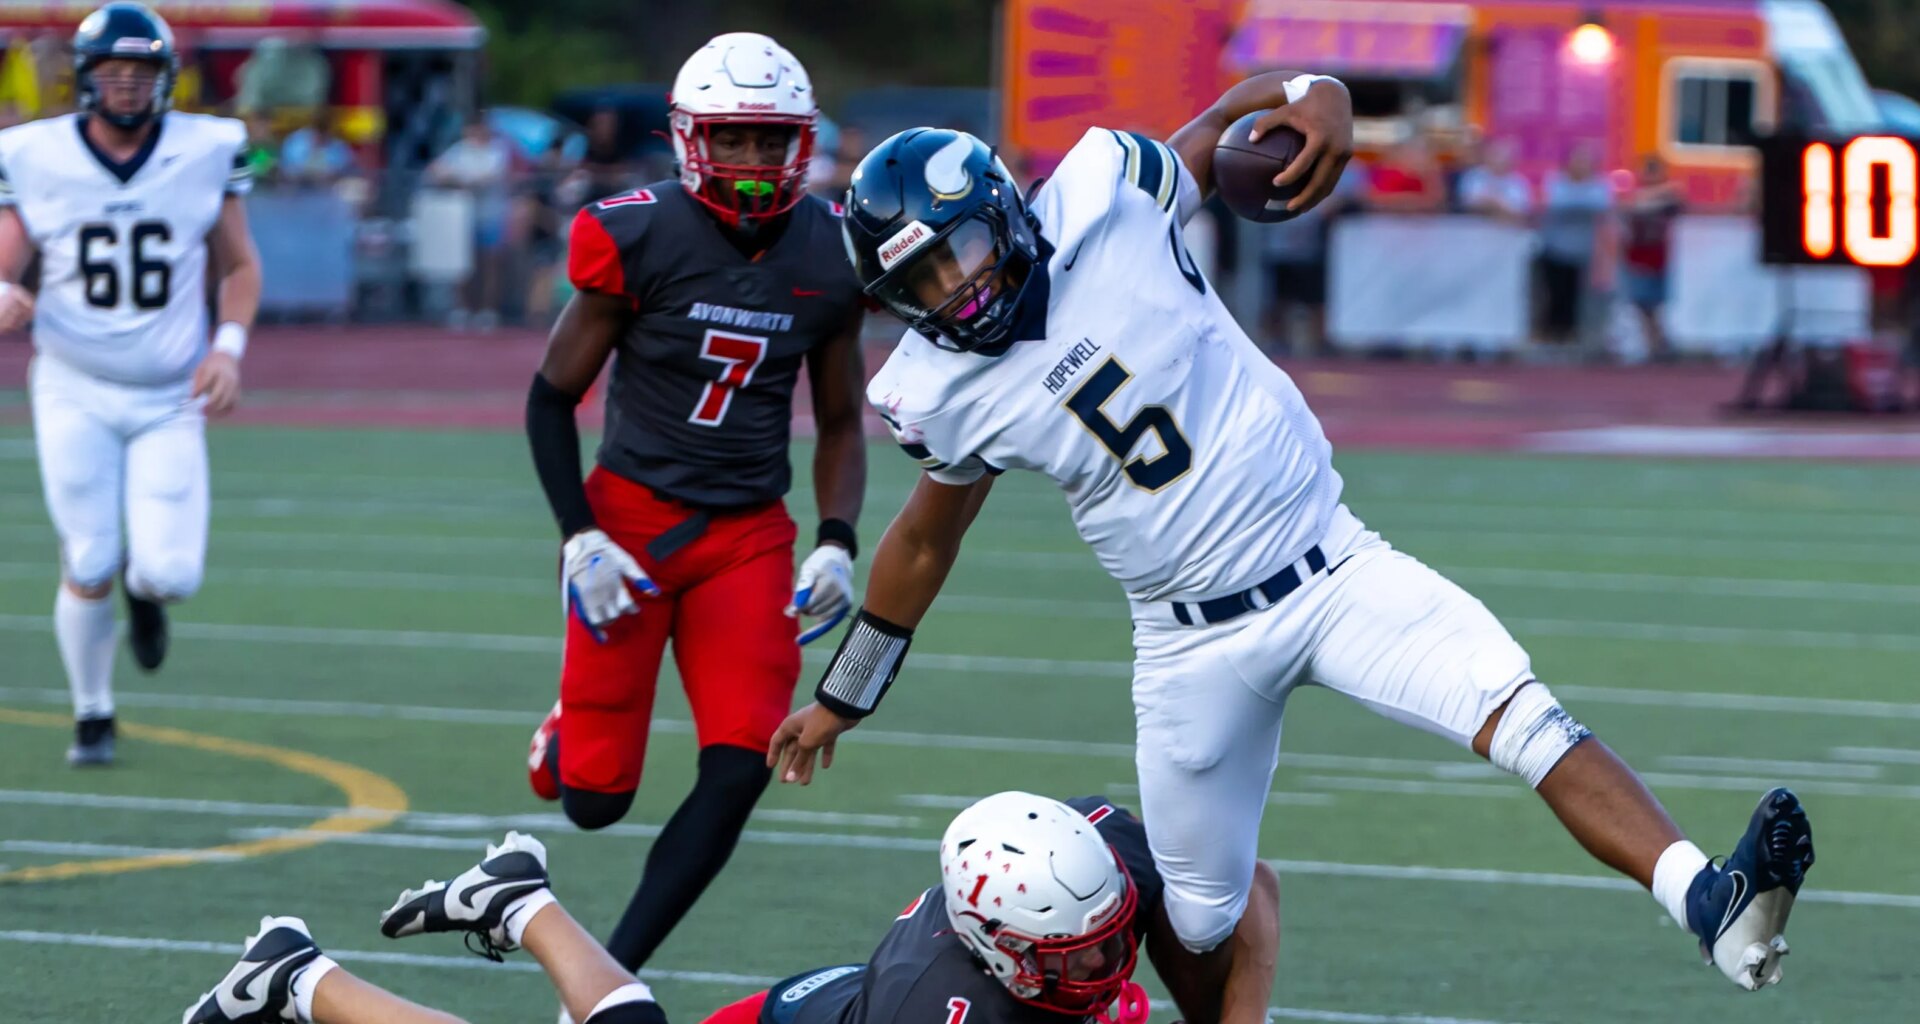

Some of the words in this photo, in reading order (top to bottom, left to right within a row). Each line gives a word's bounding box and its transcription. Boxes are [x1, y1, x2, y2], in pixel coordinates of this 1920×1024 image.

[881, 227, 924, 263] Riddell
[1802, 135, 1919, 268] 10
[79, 222, 172, 309] 66
[687, 328, 769, 427] 7
[1042, 337, 1102, 395] HOPEWELL
[1062, 353, 1195, 496] 5
[967, 874, 989, 909] 1
